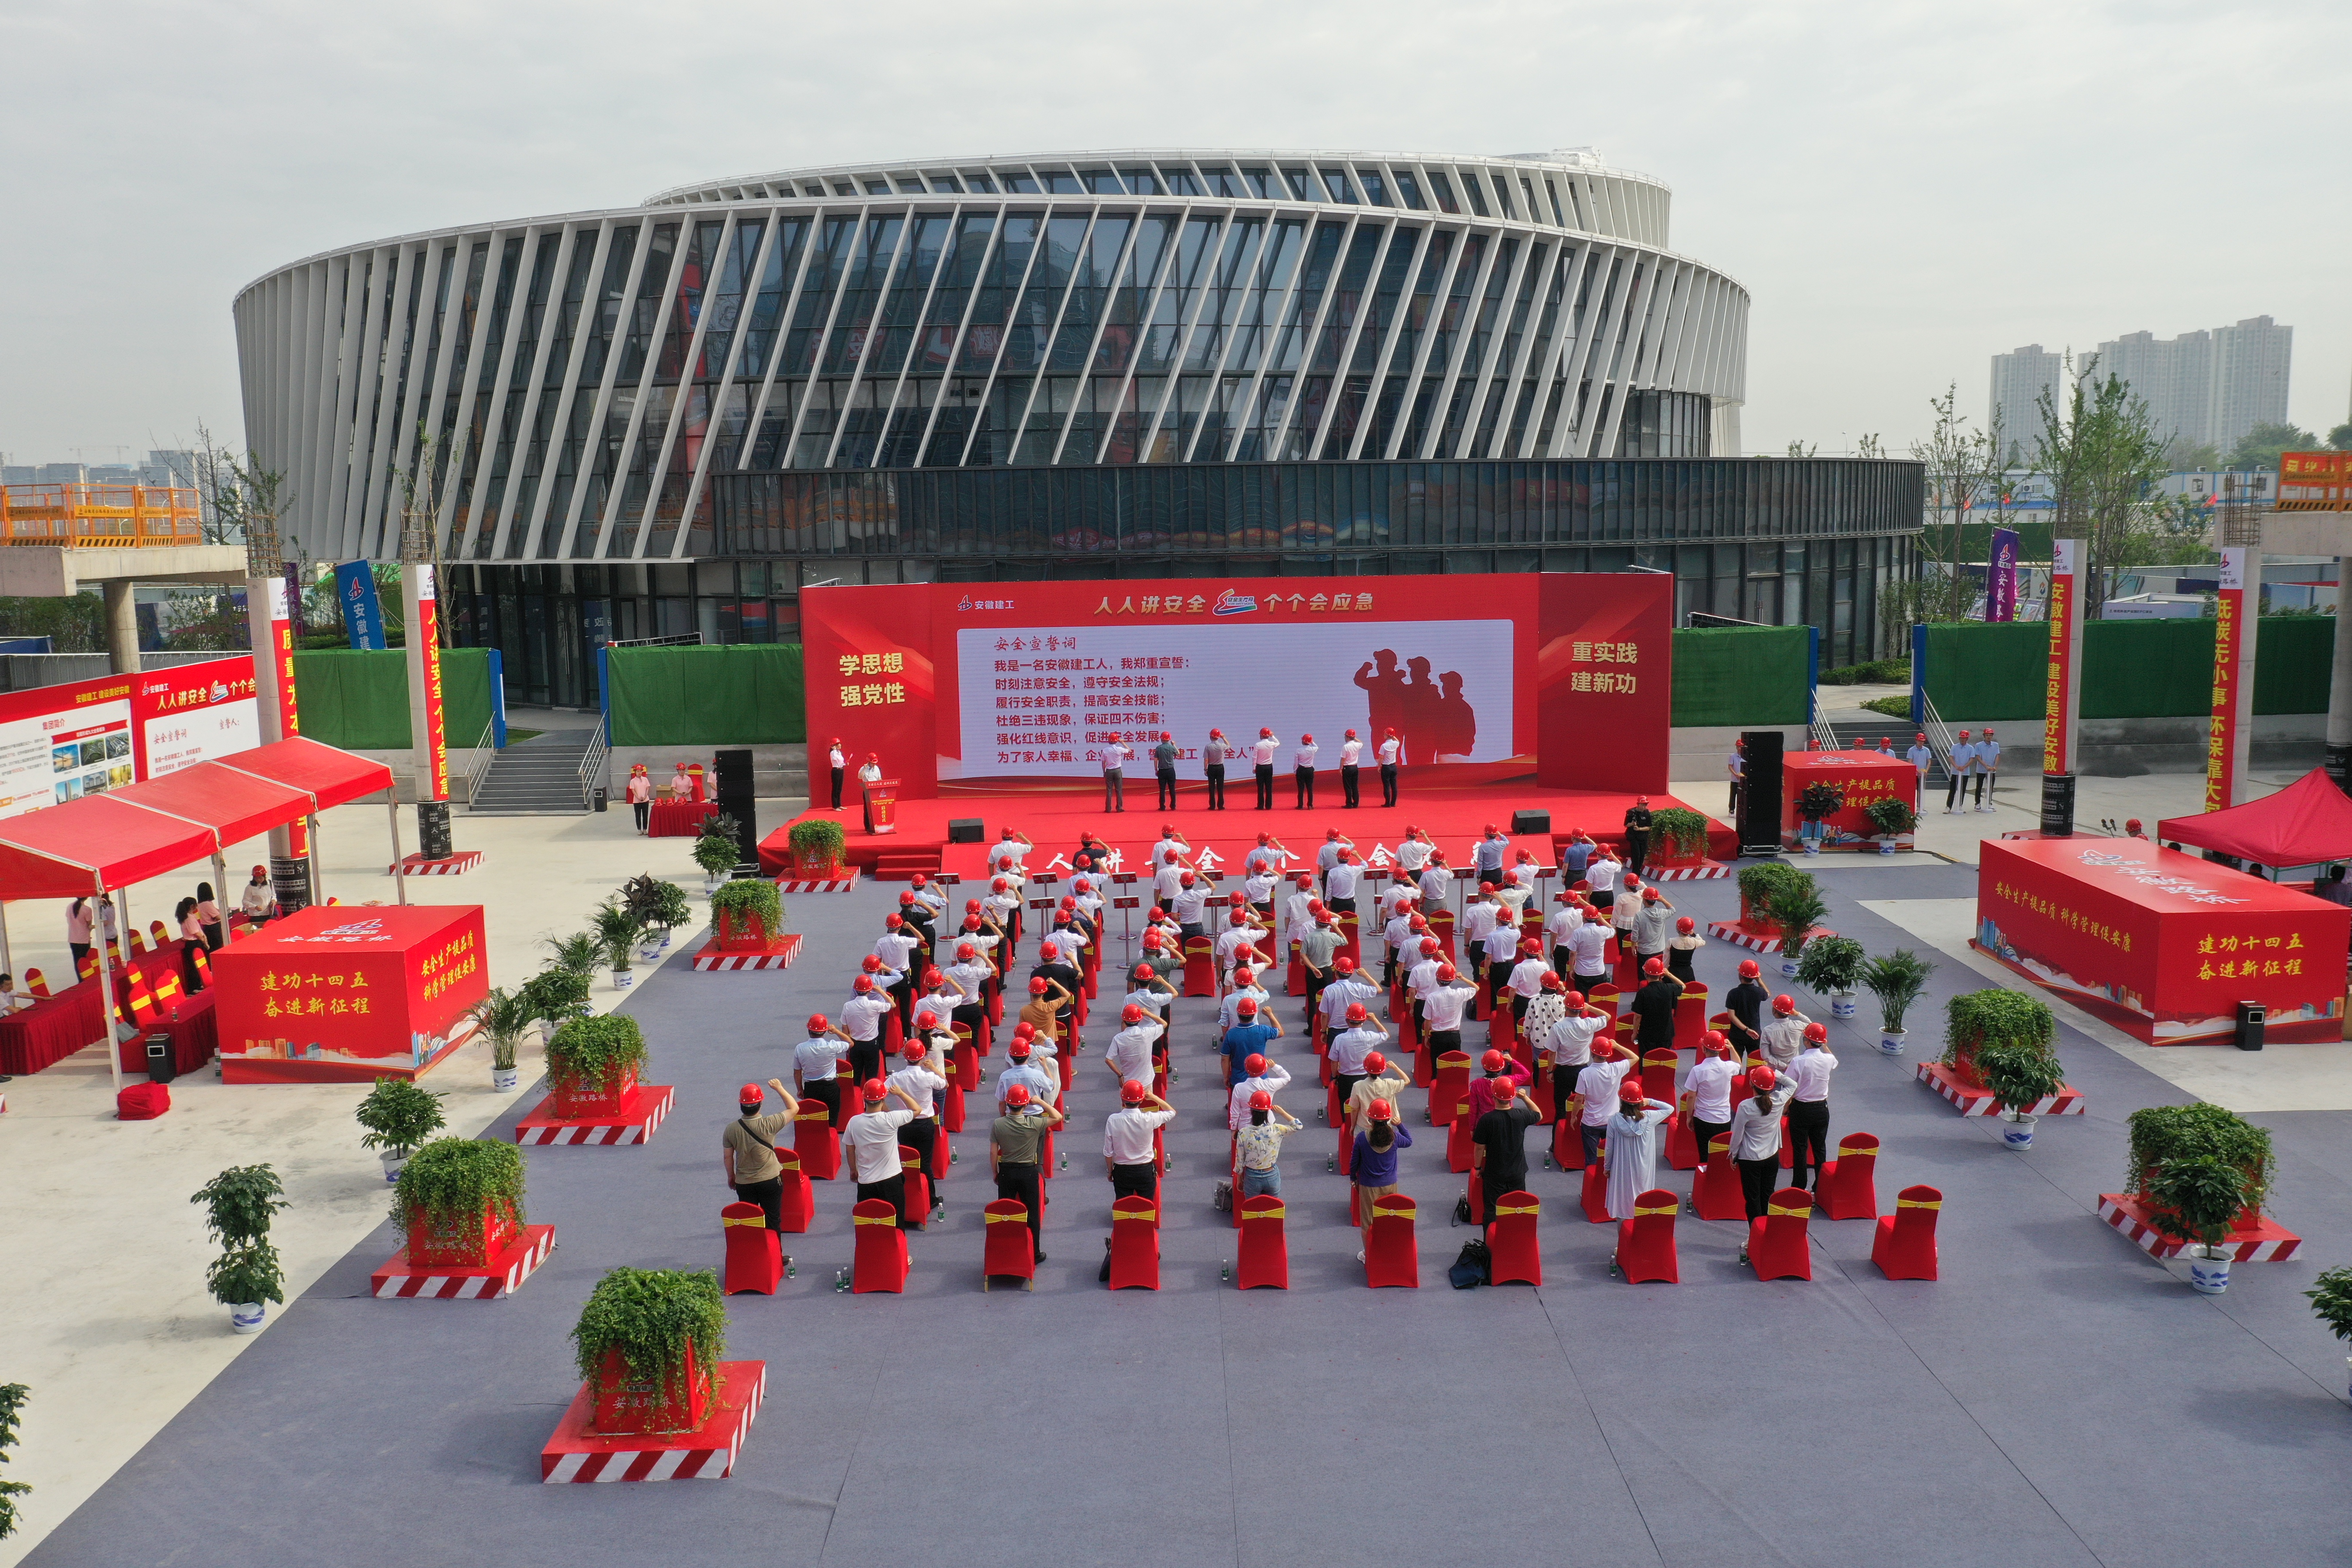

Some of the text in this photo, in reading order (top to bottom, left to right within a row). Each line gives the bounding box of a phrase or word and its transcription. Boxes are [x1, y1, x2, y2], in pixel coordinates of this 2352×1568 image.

[974, 600, 1015, 610] 安徽建工
[1093, 594, 1206, 615] 人人讲安全
[1263, 591, 1374, 612] 个个会应急
[2048, 582, 2064, 655] 安徽建工
[994, 636, 1077, 652] 安全宣誓词
[1571, 641, 1638, 665] 重实践
[838, 652, 904, 677] 学思想
[230, 677, 256, 696] 个个会
[840, 682, 906, 707] 强党性
[1571, 671, 1637, 695] 建新功
[157, 687, 207, 711] 人人讲安全
[1995, 880, 2132, 953] 安全生产提品质 科学管理促安康
[421, 930, 474, 978] 安全生产提品质
[2196, 932, 2304, 956] 建功十四五
[260, 971, 368, 991] 建功十四五
[424, 953, 477, 1003] 科学管理促安康
[2196, 958, 2303, 981] 奋进新征程
[263, 996, 371, 1017] 奋进新征程
